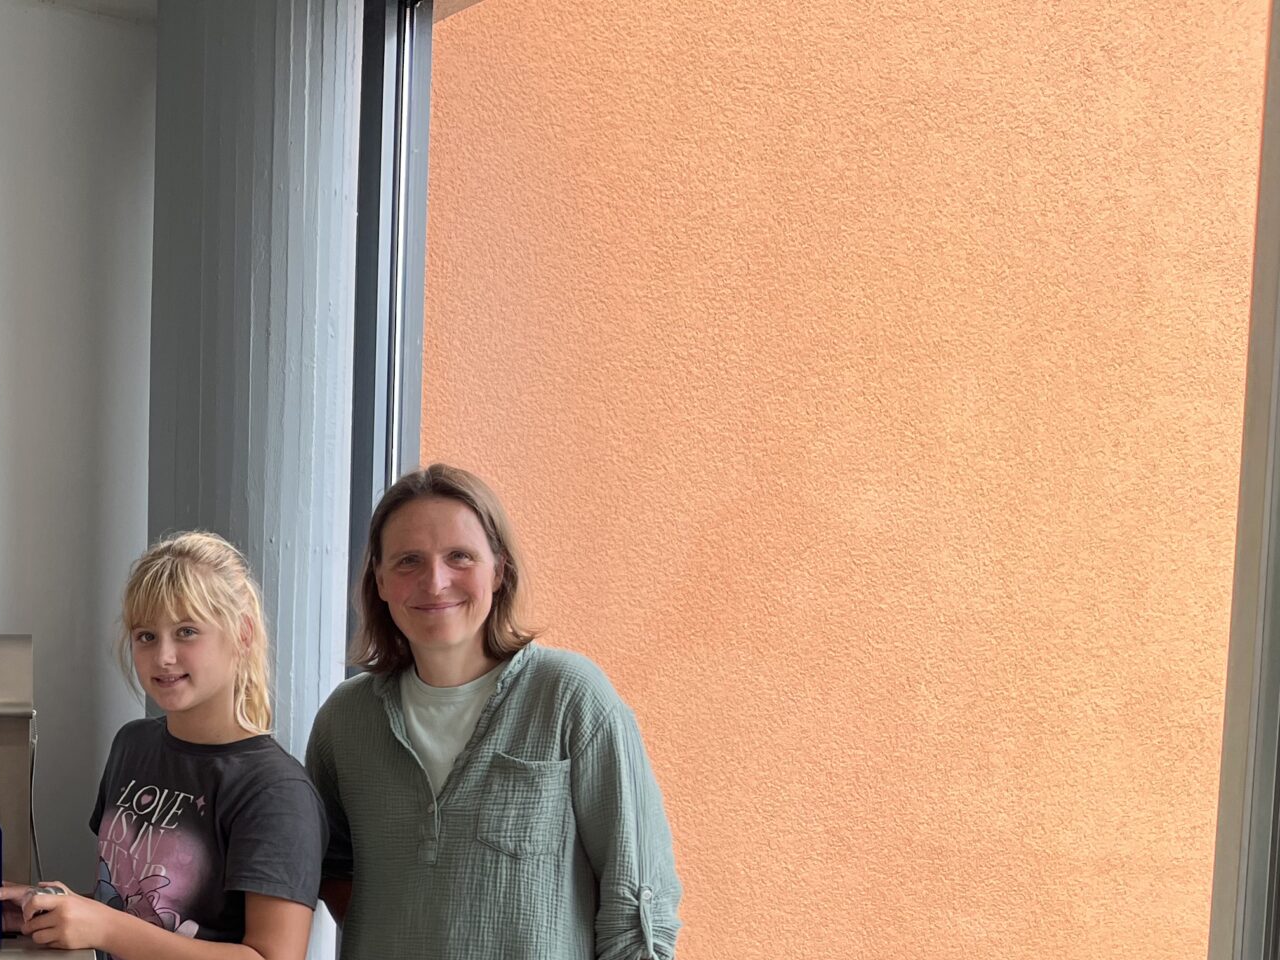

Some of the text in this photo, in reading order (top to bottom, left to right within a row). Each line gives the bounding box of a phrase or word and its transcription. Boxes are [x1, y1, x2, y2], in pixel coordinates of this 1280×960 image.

[116, 780, 194, 829] LOVE
[107, 807, 165, 864] IS IN
